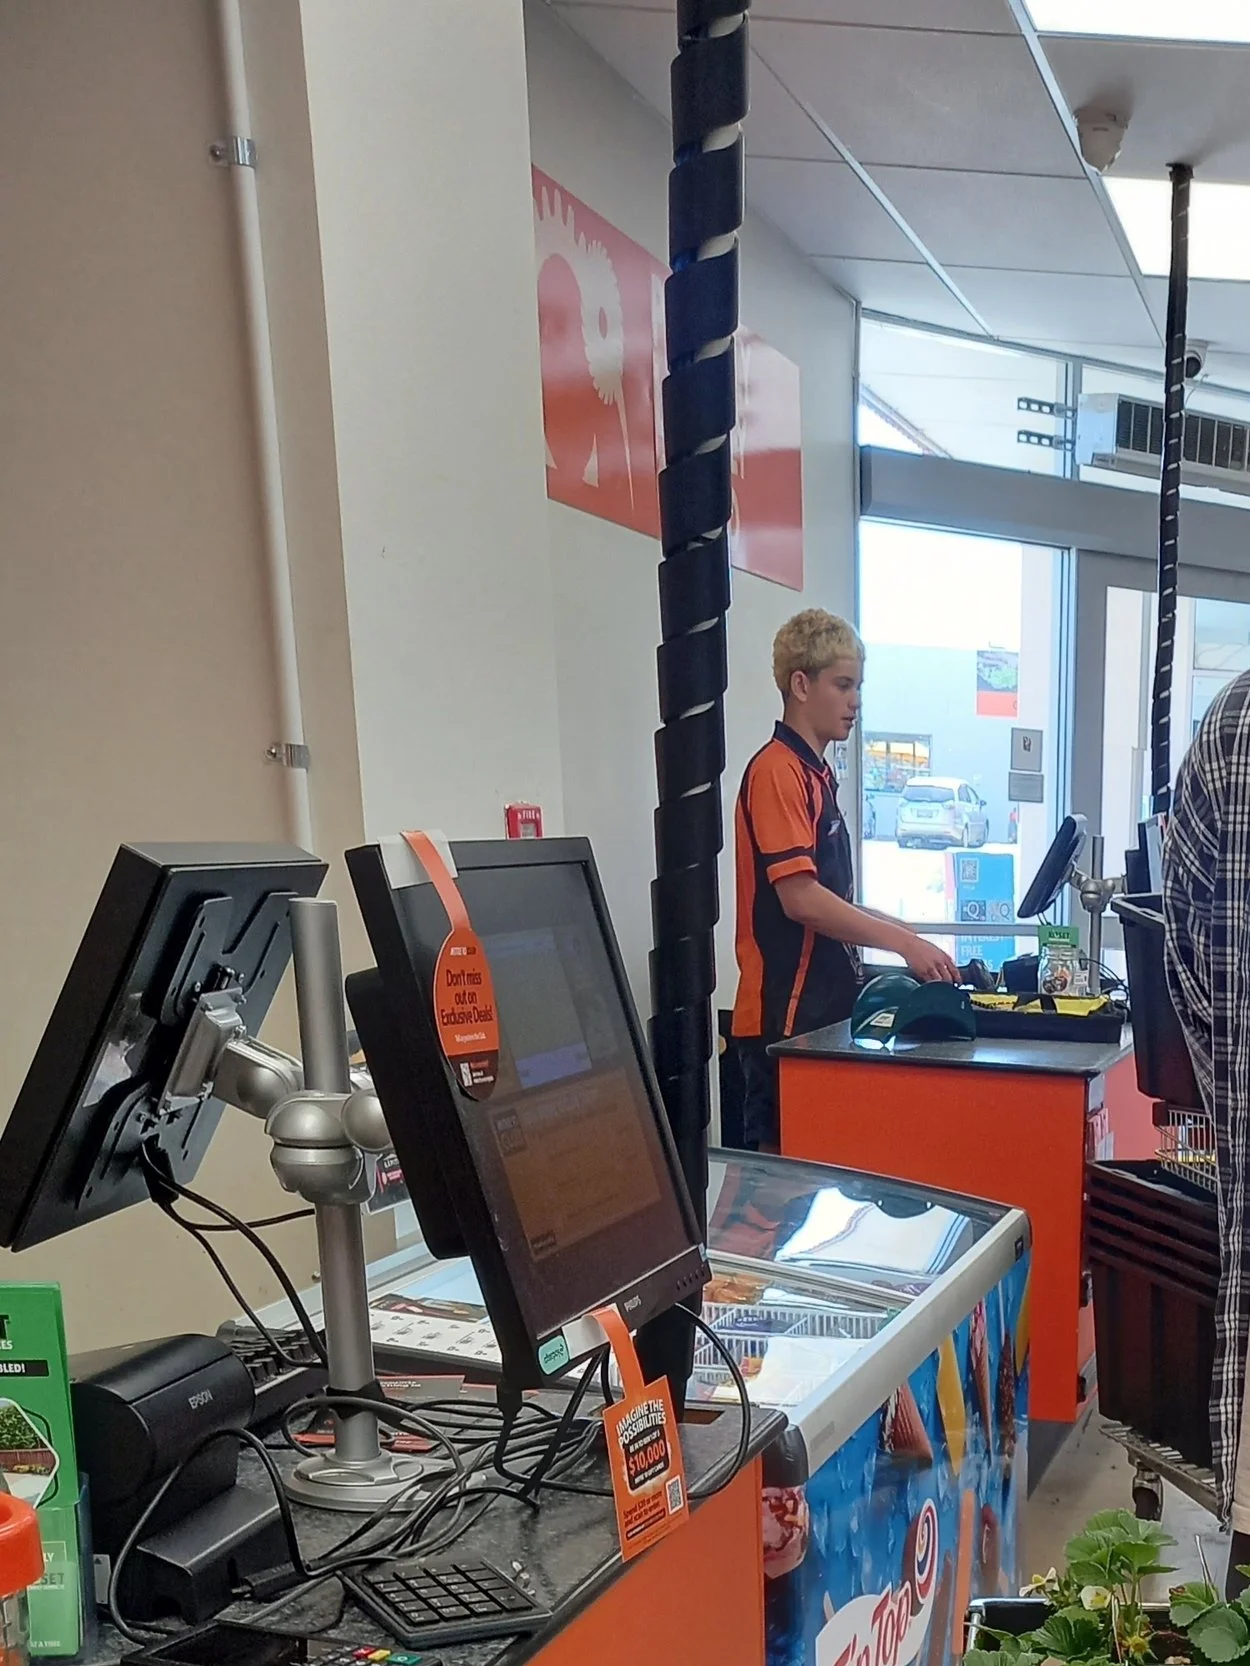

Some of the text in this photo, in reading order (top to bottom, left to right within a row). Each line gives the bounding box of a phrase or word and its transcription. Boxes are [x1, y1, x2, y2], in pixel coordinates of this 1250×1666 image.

[446, 968, 482, 987] Don't miss
[454, 991, 478, 1005] out on
[616, 1399, 664, 1438] IMAGINE THE
[618, 1411, 667, 1450] POSSIBILITIES
[628, 1439, 666, 1477] $10,000
